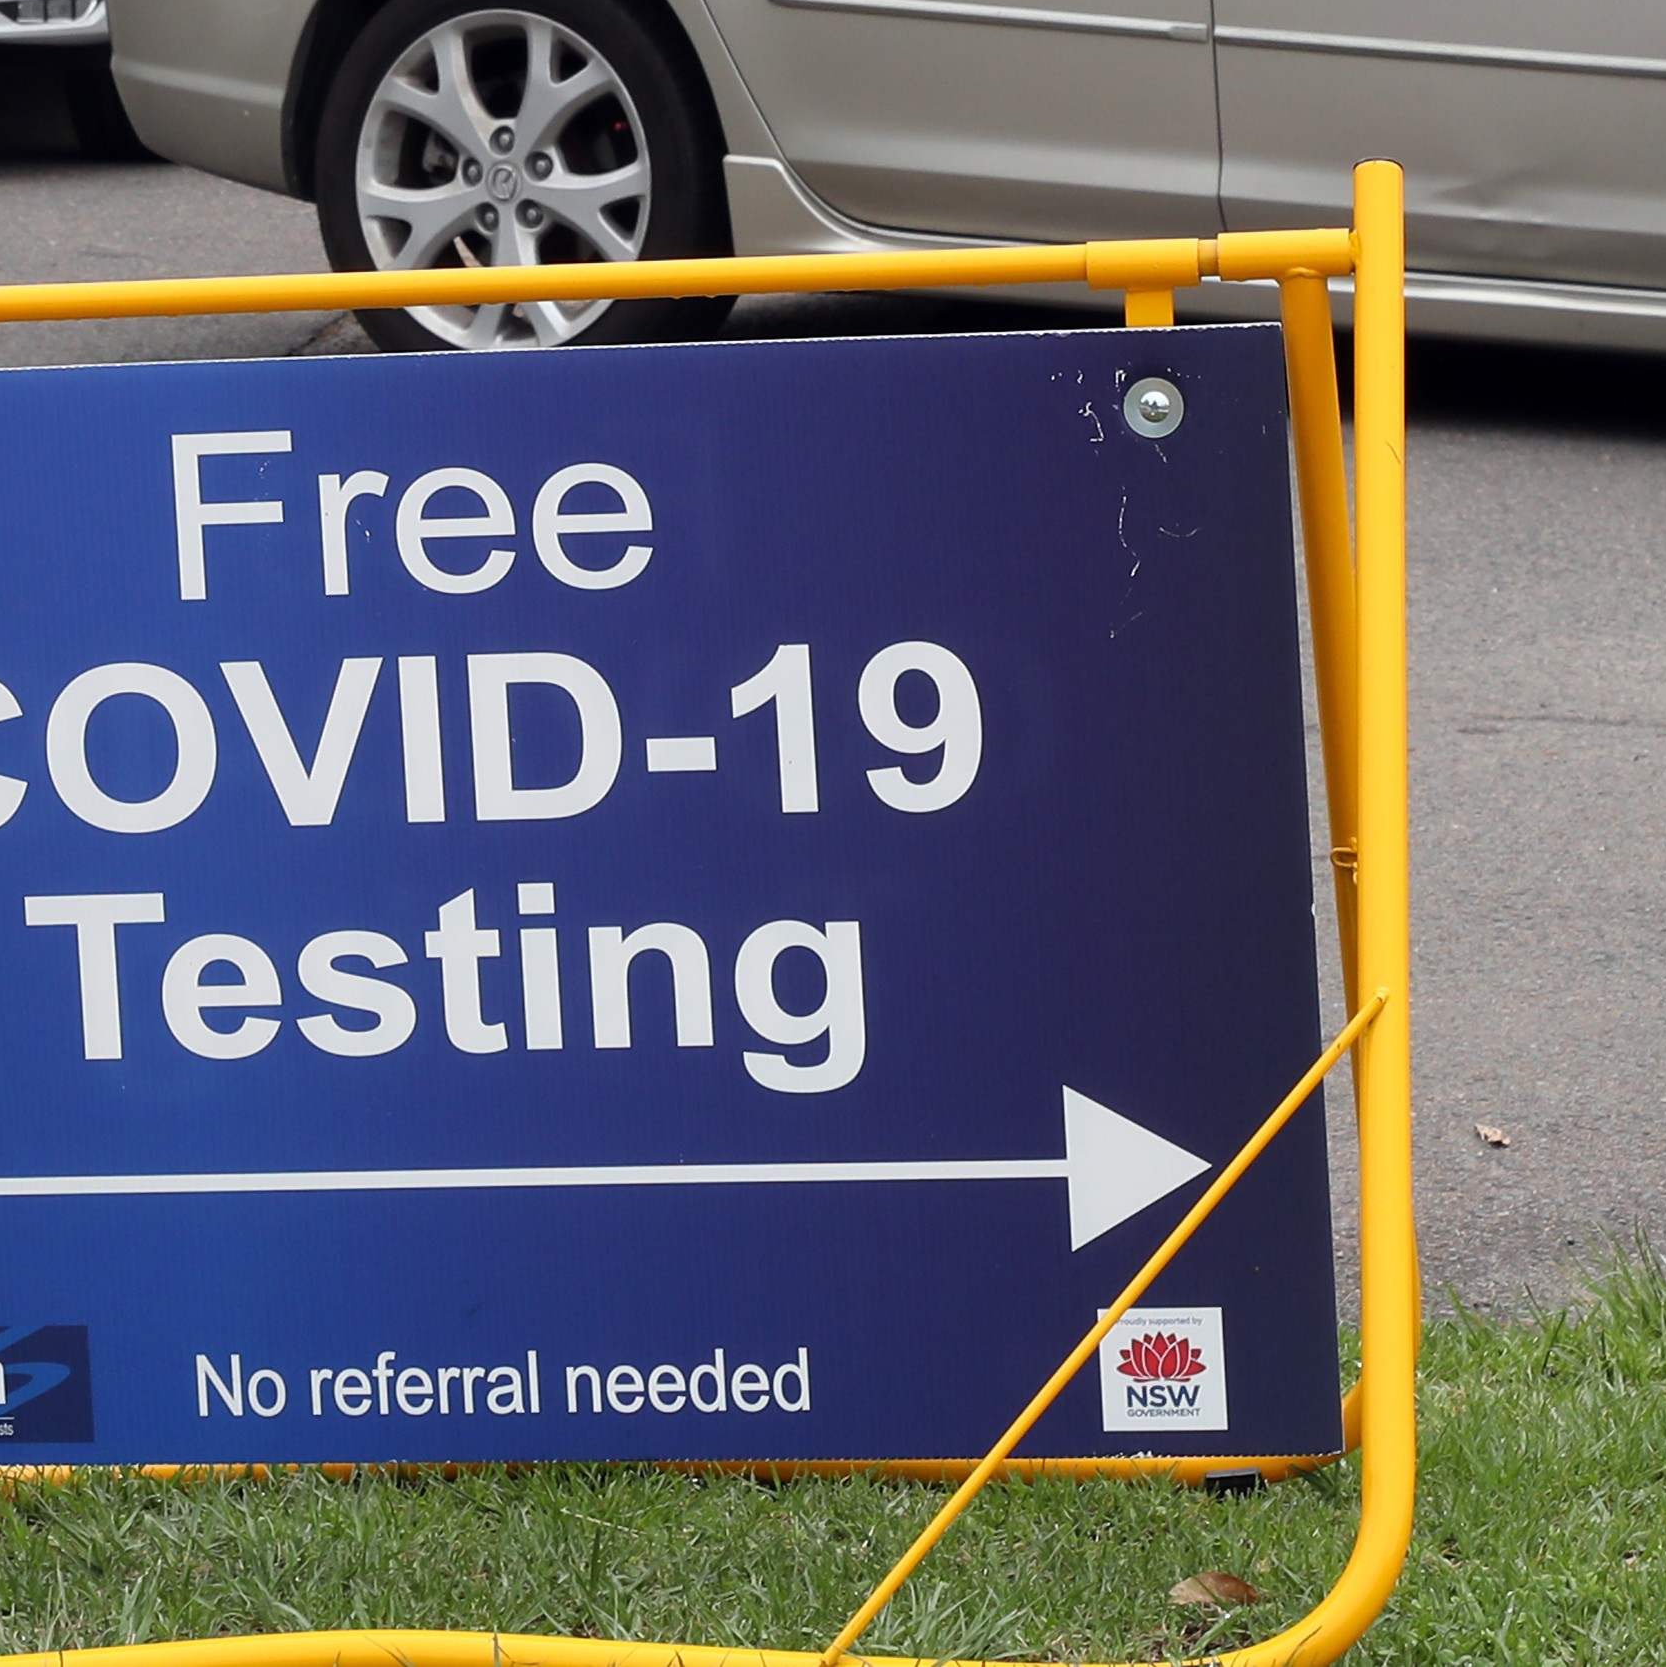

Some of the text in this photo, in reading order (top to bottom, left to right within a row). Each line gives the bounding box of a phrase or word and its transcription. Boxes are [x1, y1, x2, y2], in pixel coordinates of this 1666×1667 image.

[170, 429, 655, 602] Free
[22, 881, 867, 1095] Testing
[1148, 1317, 1190, 1326] supported
[1191, 1316, 1203, 1326] by
[194, 1346, 812, 1418] No referral needed
[1126, 1384, 1201, 1408] NSW
[1127, 1408, 1201, 1418] GOVERNMENT
